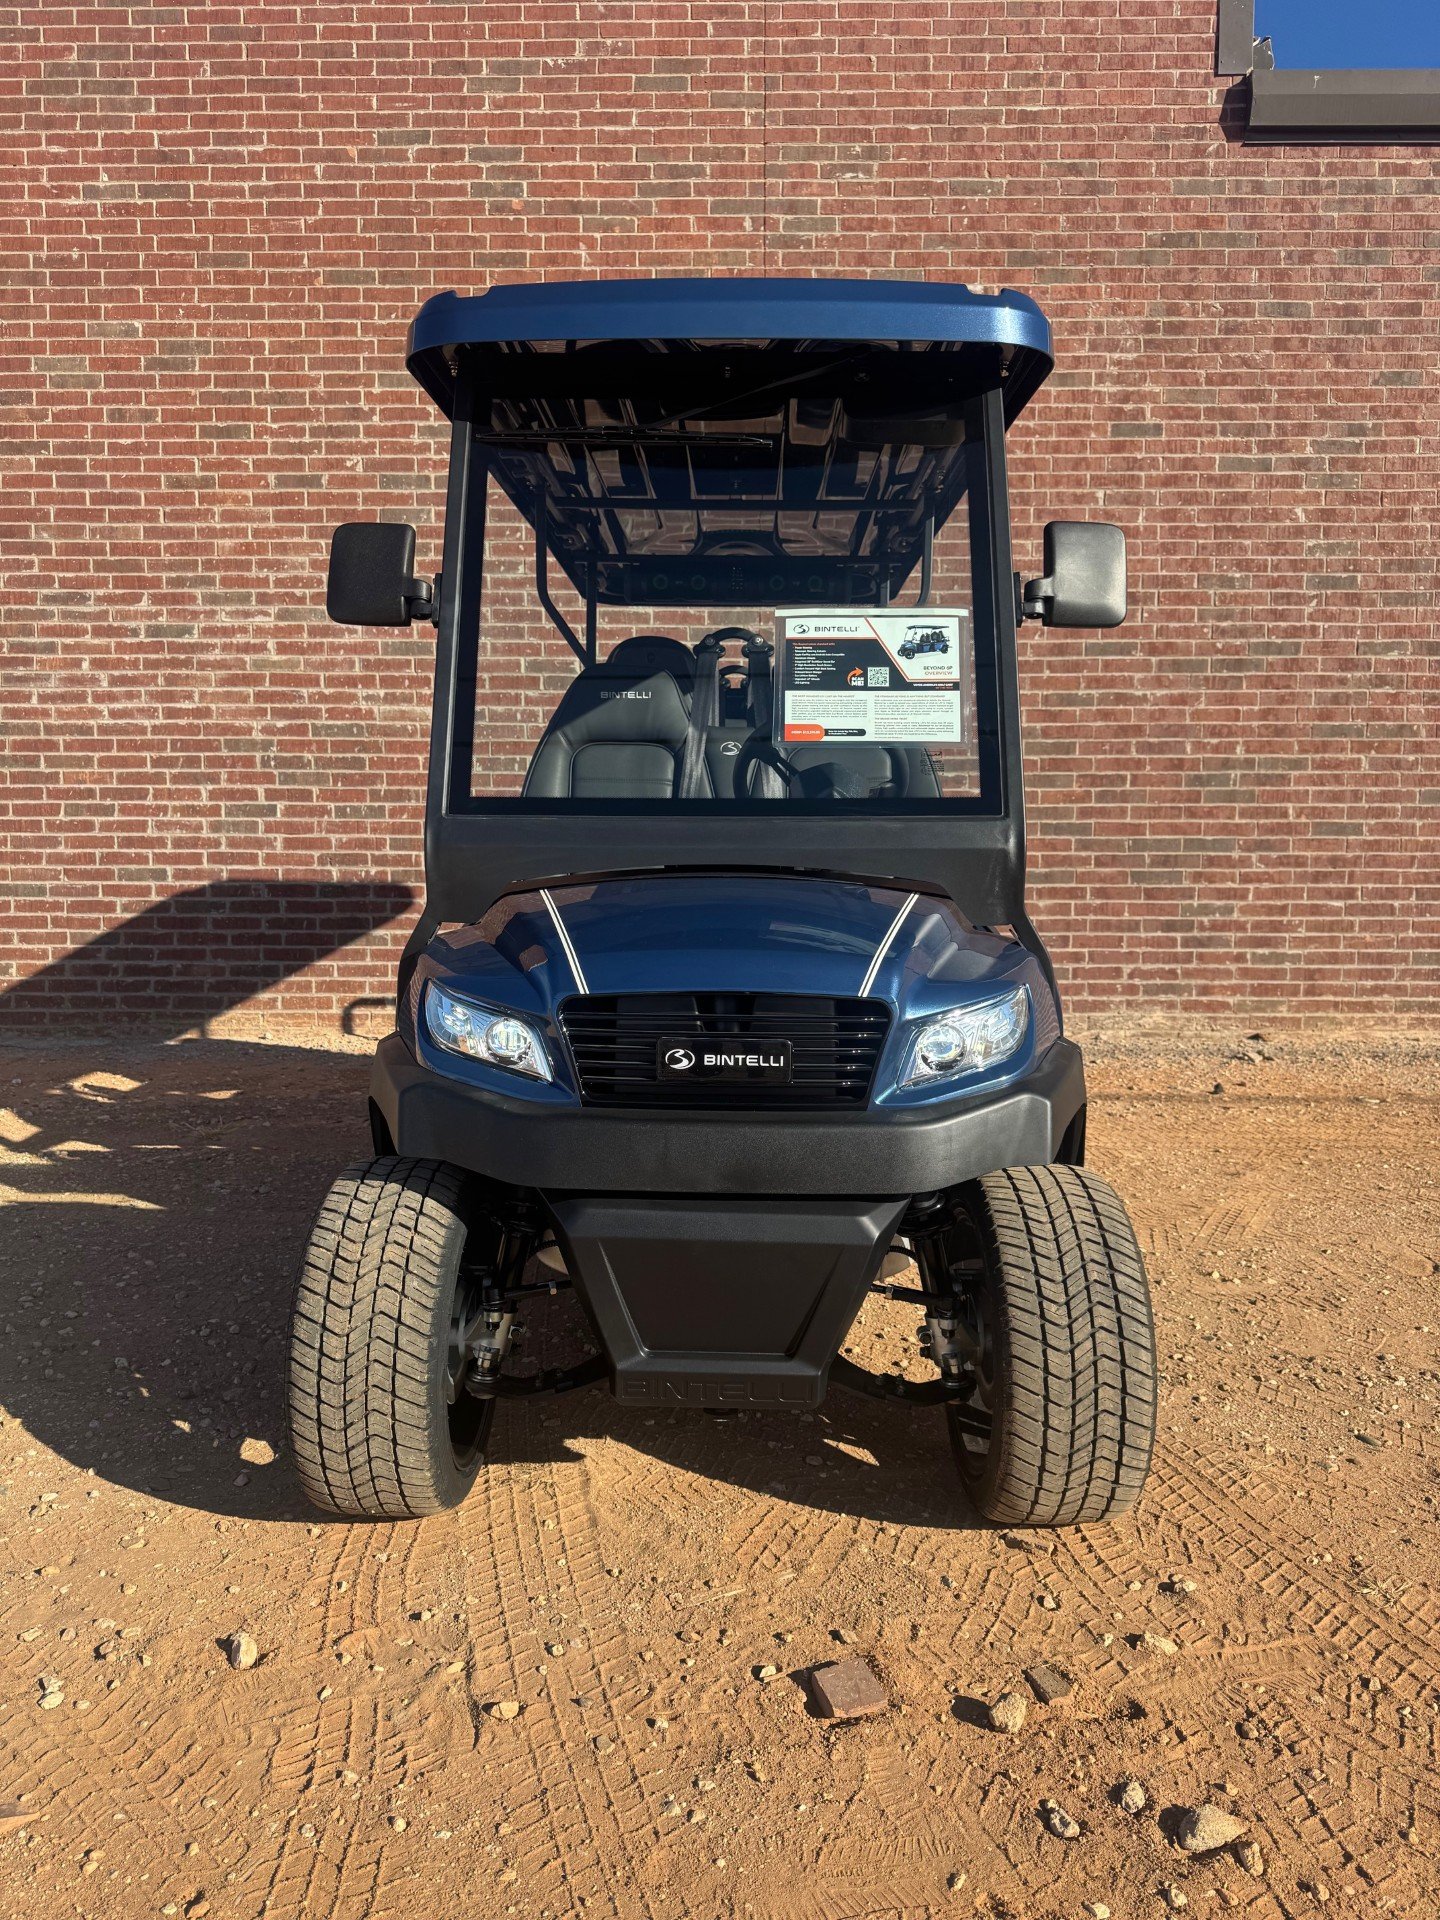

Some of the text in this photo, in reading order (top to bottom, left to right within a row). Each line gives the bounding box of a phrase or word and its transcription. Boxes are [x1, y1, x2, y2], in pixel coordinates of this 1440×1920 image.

[600, 691, 652, 699] BINTELLI
[703, 1054, 784, 1067] BINTELLI
[621, 1381, 814, 1403] BINTELLI
